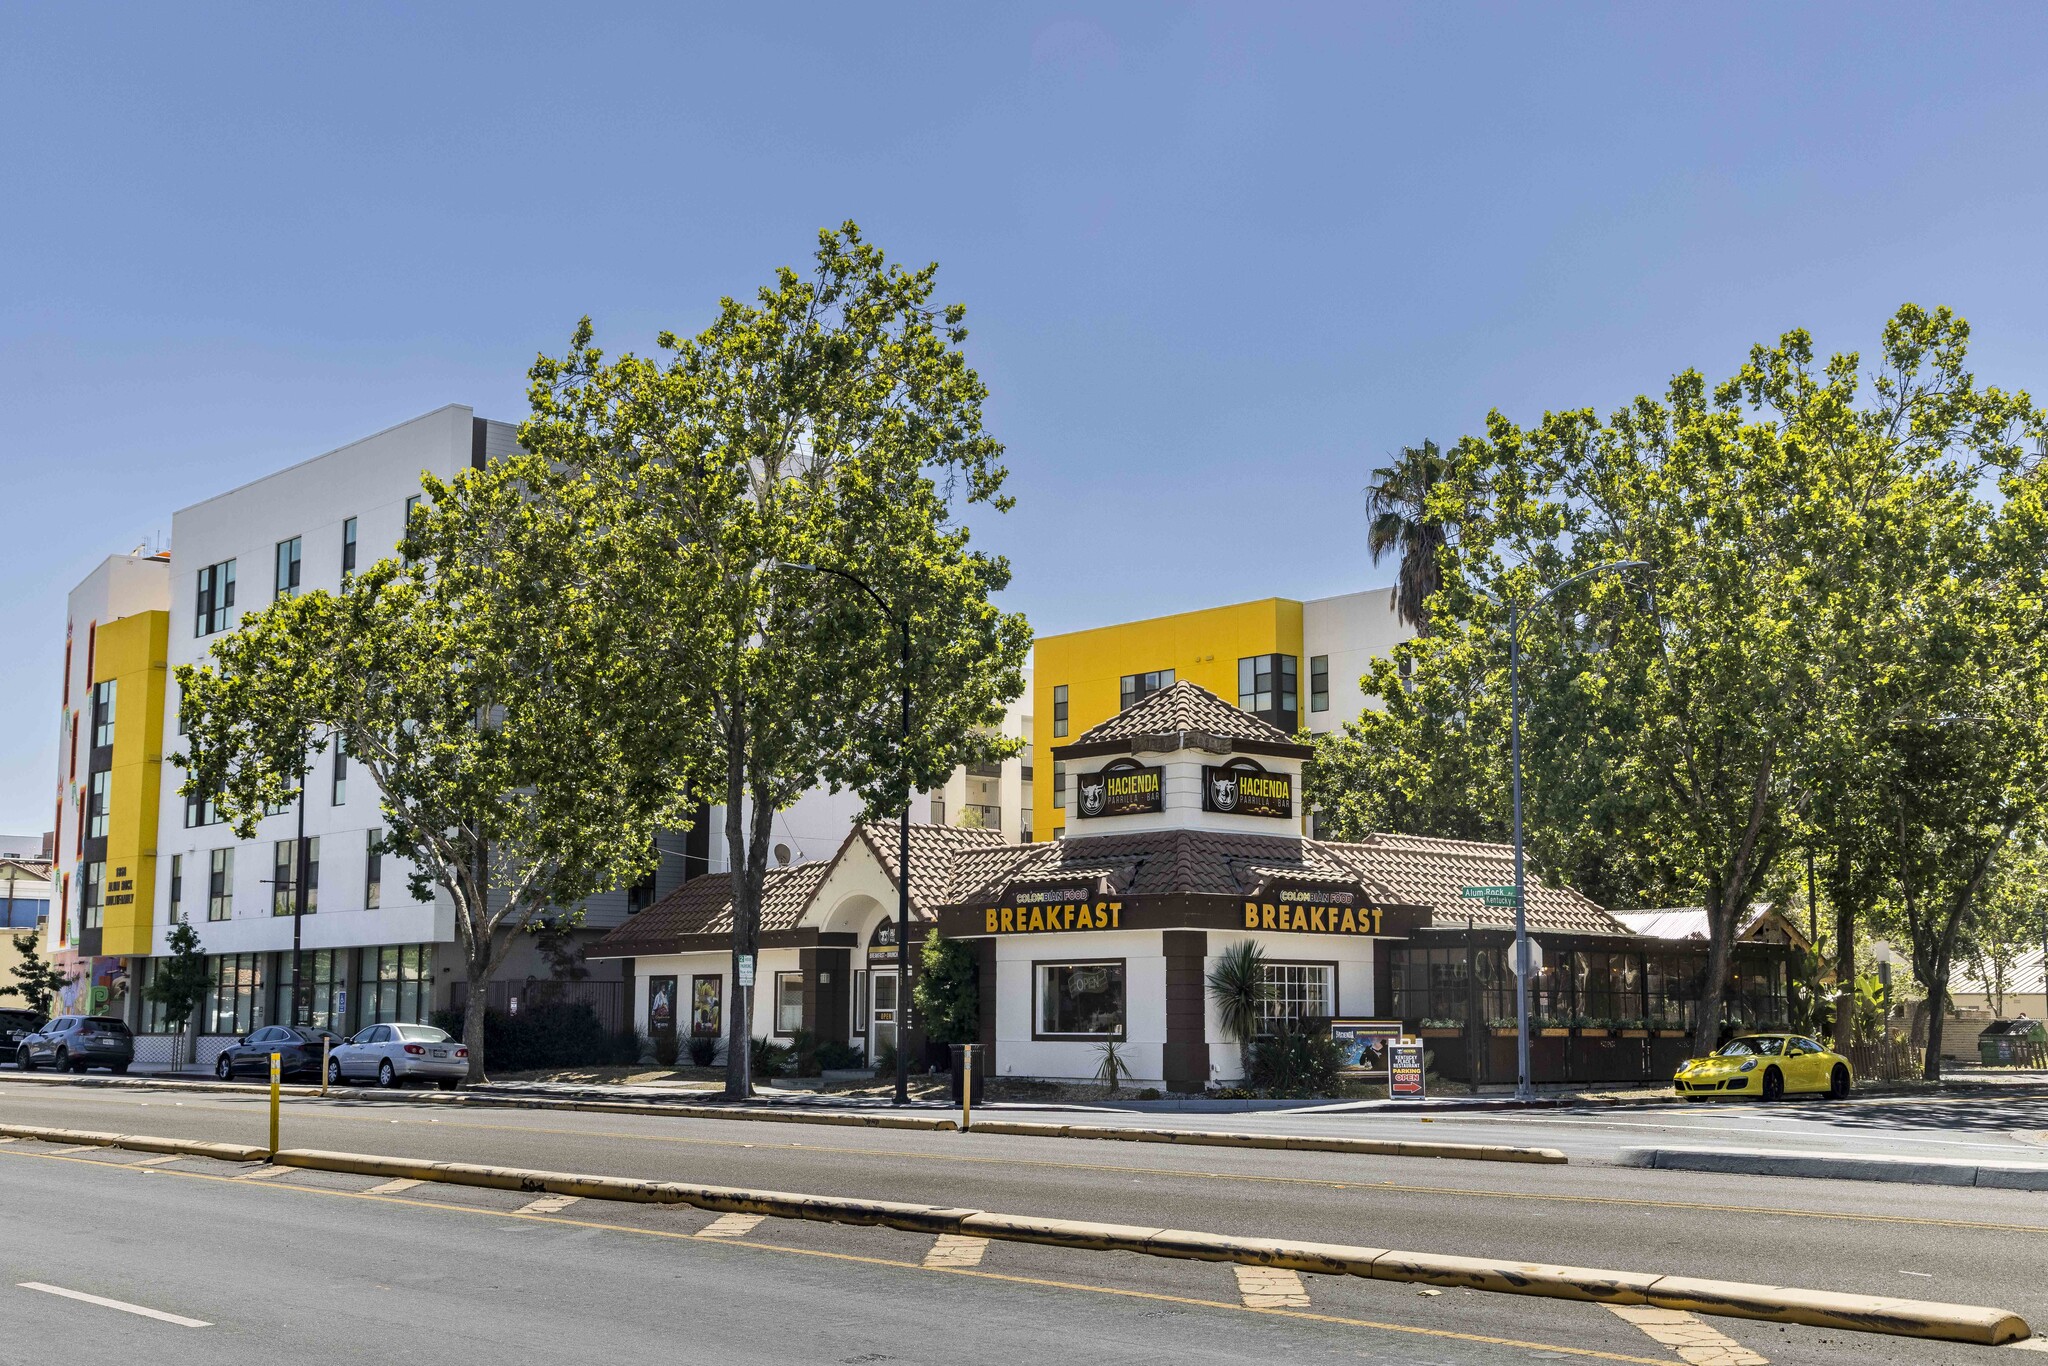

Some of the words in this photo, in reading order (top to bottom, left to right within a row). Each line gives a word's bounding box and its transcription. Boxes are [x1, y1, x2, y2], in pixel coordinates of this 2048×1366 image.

[1107, 774, 1159, 796] HACIENDA
[1240, 776, 1290, 799] HACIENDA
[1107, 794, 1138, 805] PARRILLA
[1146, 792, 1160, 802] BAR
[1240, 795, 1270, 806] PARRILLA
[1277, 800, 1290, 808] BAR
[1016, 890, 1064, 904] COLOMBIAN
[1063, 888, 1088, 901] FOOD
[1280, 889, 1330, 903] COLOMBIAN
[1330, 892, 1354, 904] FOOD
[1486, 896, 1511, 906] Kentucky
[986, 902, 1122, 933] BREAKFAST
[1245, 902, 1383, 934] BREAKFAST
[1076, 974, 1100, 991] OPEN
[880, 1012, 892, 1020] OPEN
[1395, 1073, 1420, 1082] OPEN
